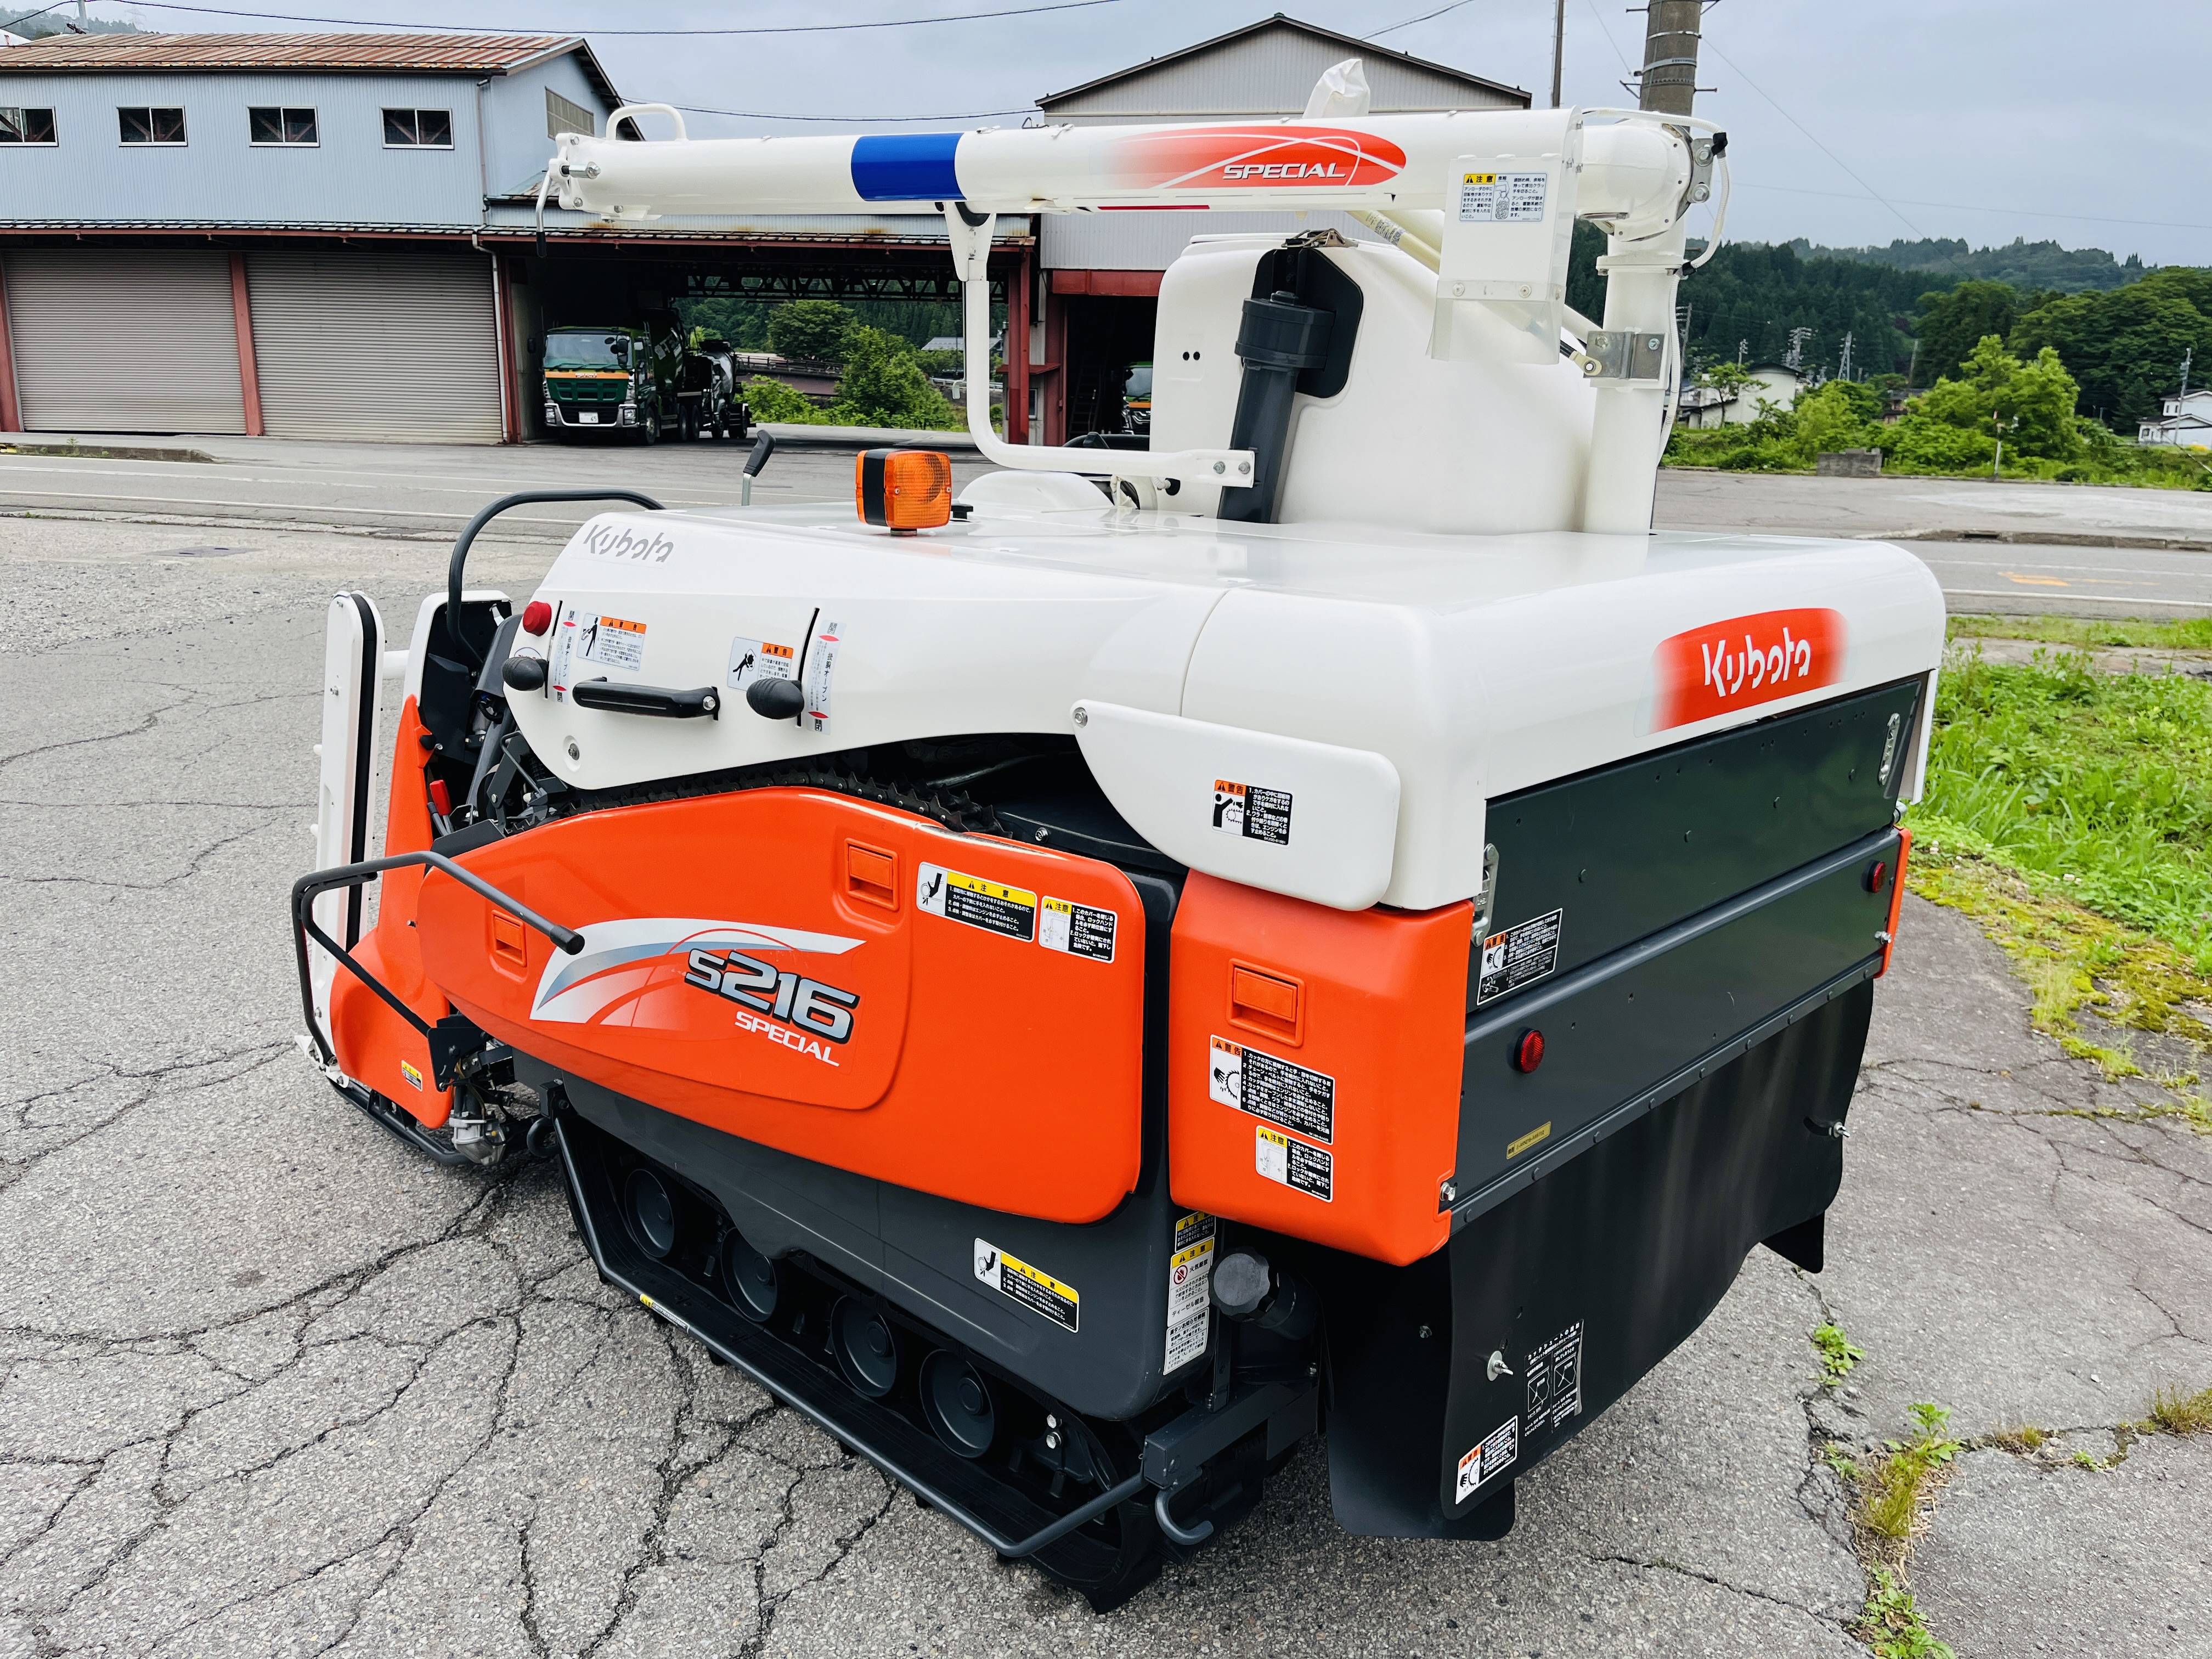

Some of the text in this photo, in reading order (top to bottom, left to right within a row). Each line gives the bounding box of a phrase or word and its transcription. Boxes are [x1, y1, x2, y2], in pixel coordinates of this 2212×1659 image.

[1223, 163, 1346, 179] SPECIAL
[583, 524, 674, 562] Kubota
[1701, 627, 1810, 697] Kubota
[1251, 805, 1267, 813] いこと。
[980, 883, 1009, 898] 注意
[1054, 901, 1068, 912] 注意
[1074, 924, 1089, 934] ること。
[684, 947, 860, 1044] S216
[735, 1011, 840, 1067] SPECIAL
[1224, 1042, 1241, 1056] 警告
[1270, 1133, 1284, 1145] 注意
[1291, 1159, 1306, 1170] ること。
[1189, 1243, 1206, 1258] 注意
[1030, 1270, 1055, 1290] 注意
